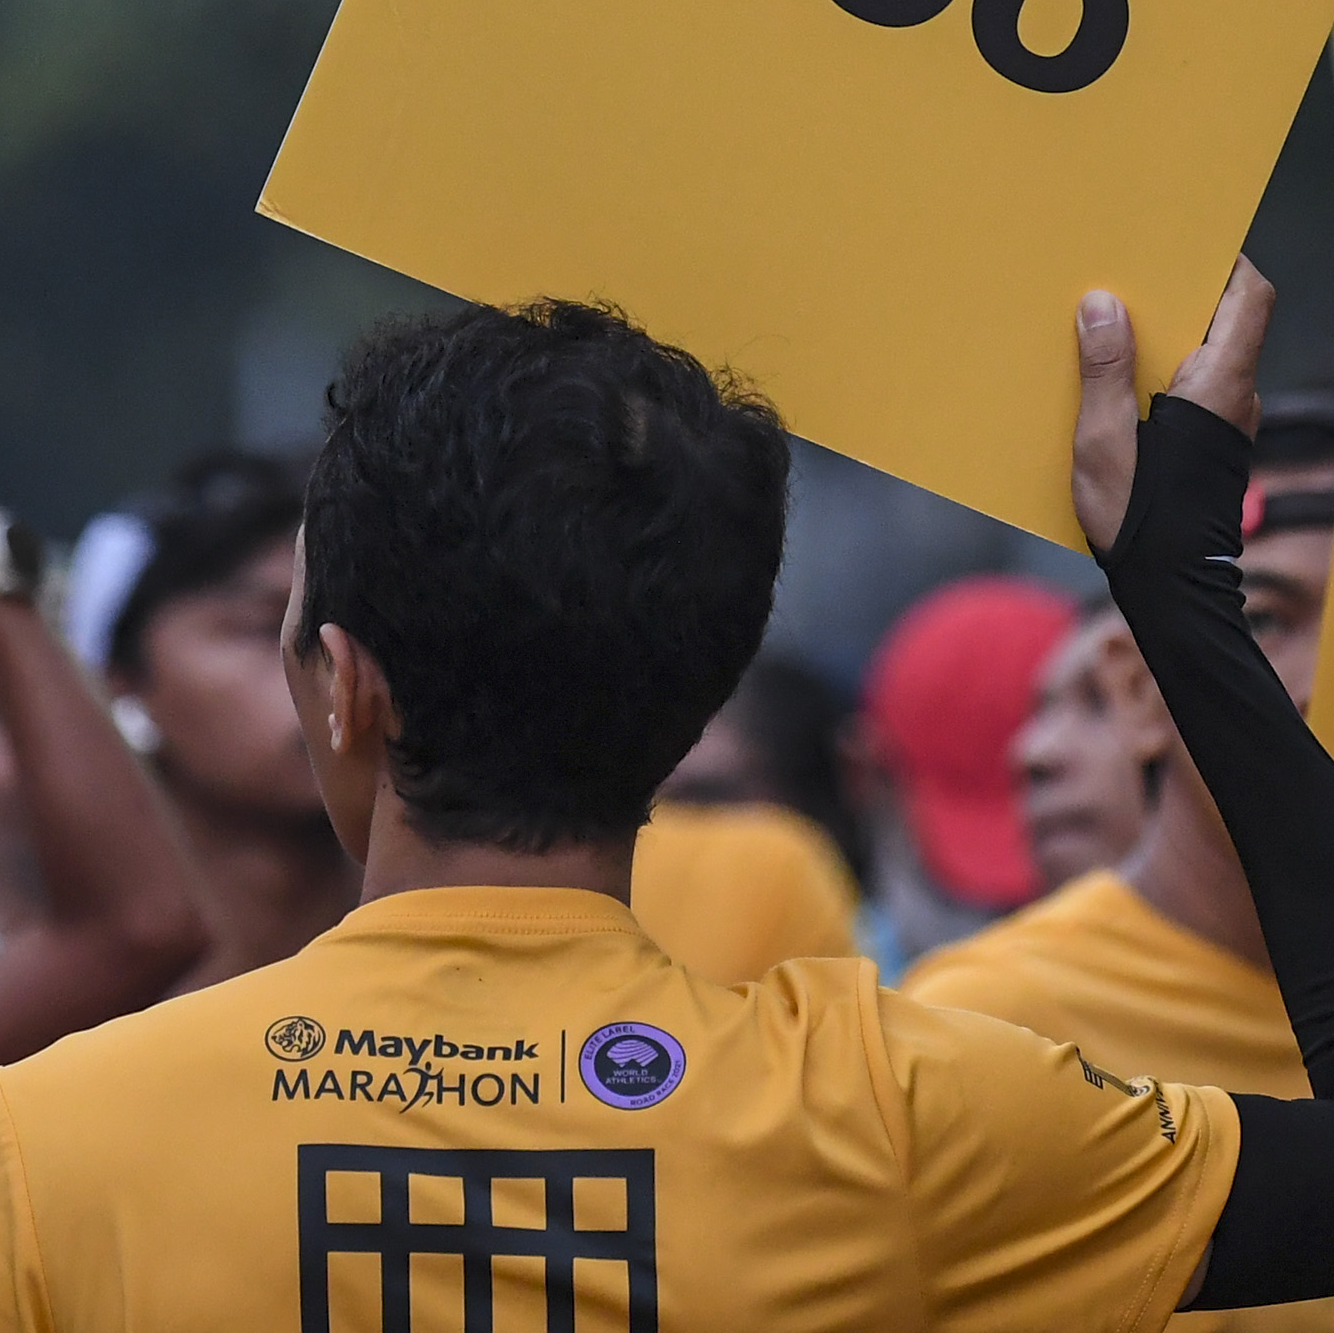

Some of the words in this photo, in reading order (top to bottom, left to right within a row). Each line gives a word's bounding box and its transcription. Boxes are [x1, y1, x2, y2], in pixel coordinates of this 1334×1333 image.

[334, 1029, 539, 1066] Maybank
[584, 1037, 603, 1060] ELITE
[602, 1025, 635, 1039] LABEL
[272, 1063, 540, 1114] MARATHON
[605, 1076, 658, 1085] ATHLETICS
[613, 1069, 649, 1078] WORLD
[630, 1095, 656, 1106] ROAD
[656, 1080, 675, 1096] RACE
